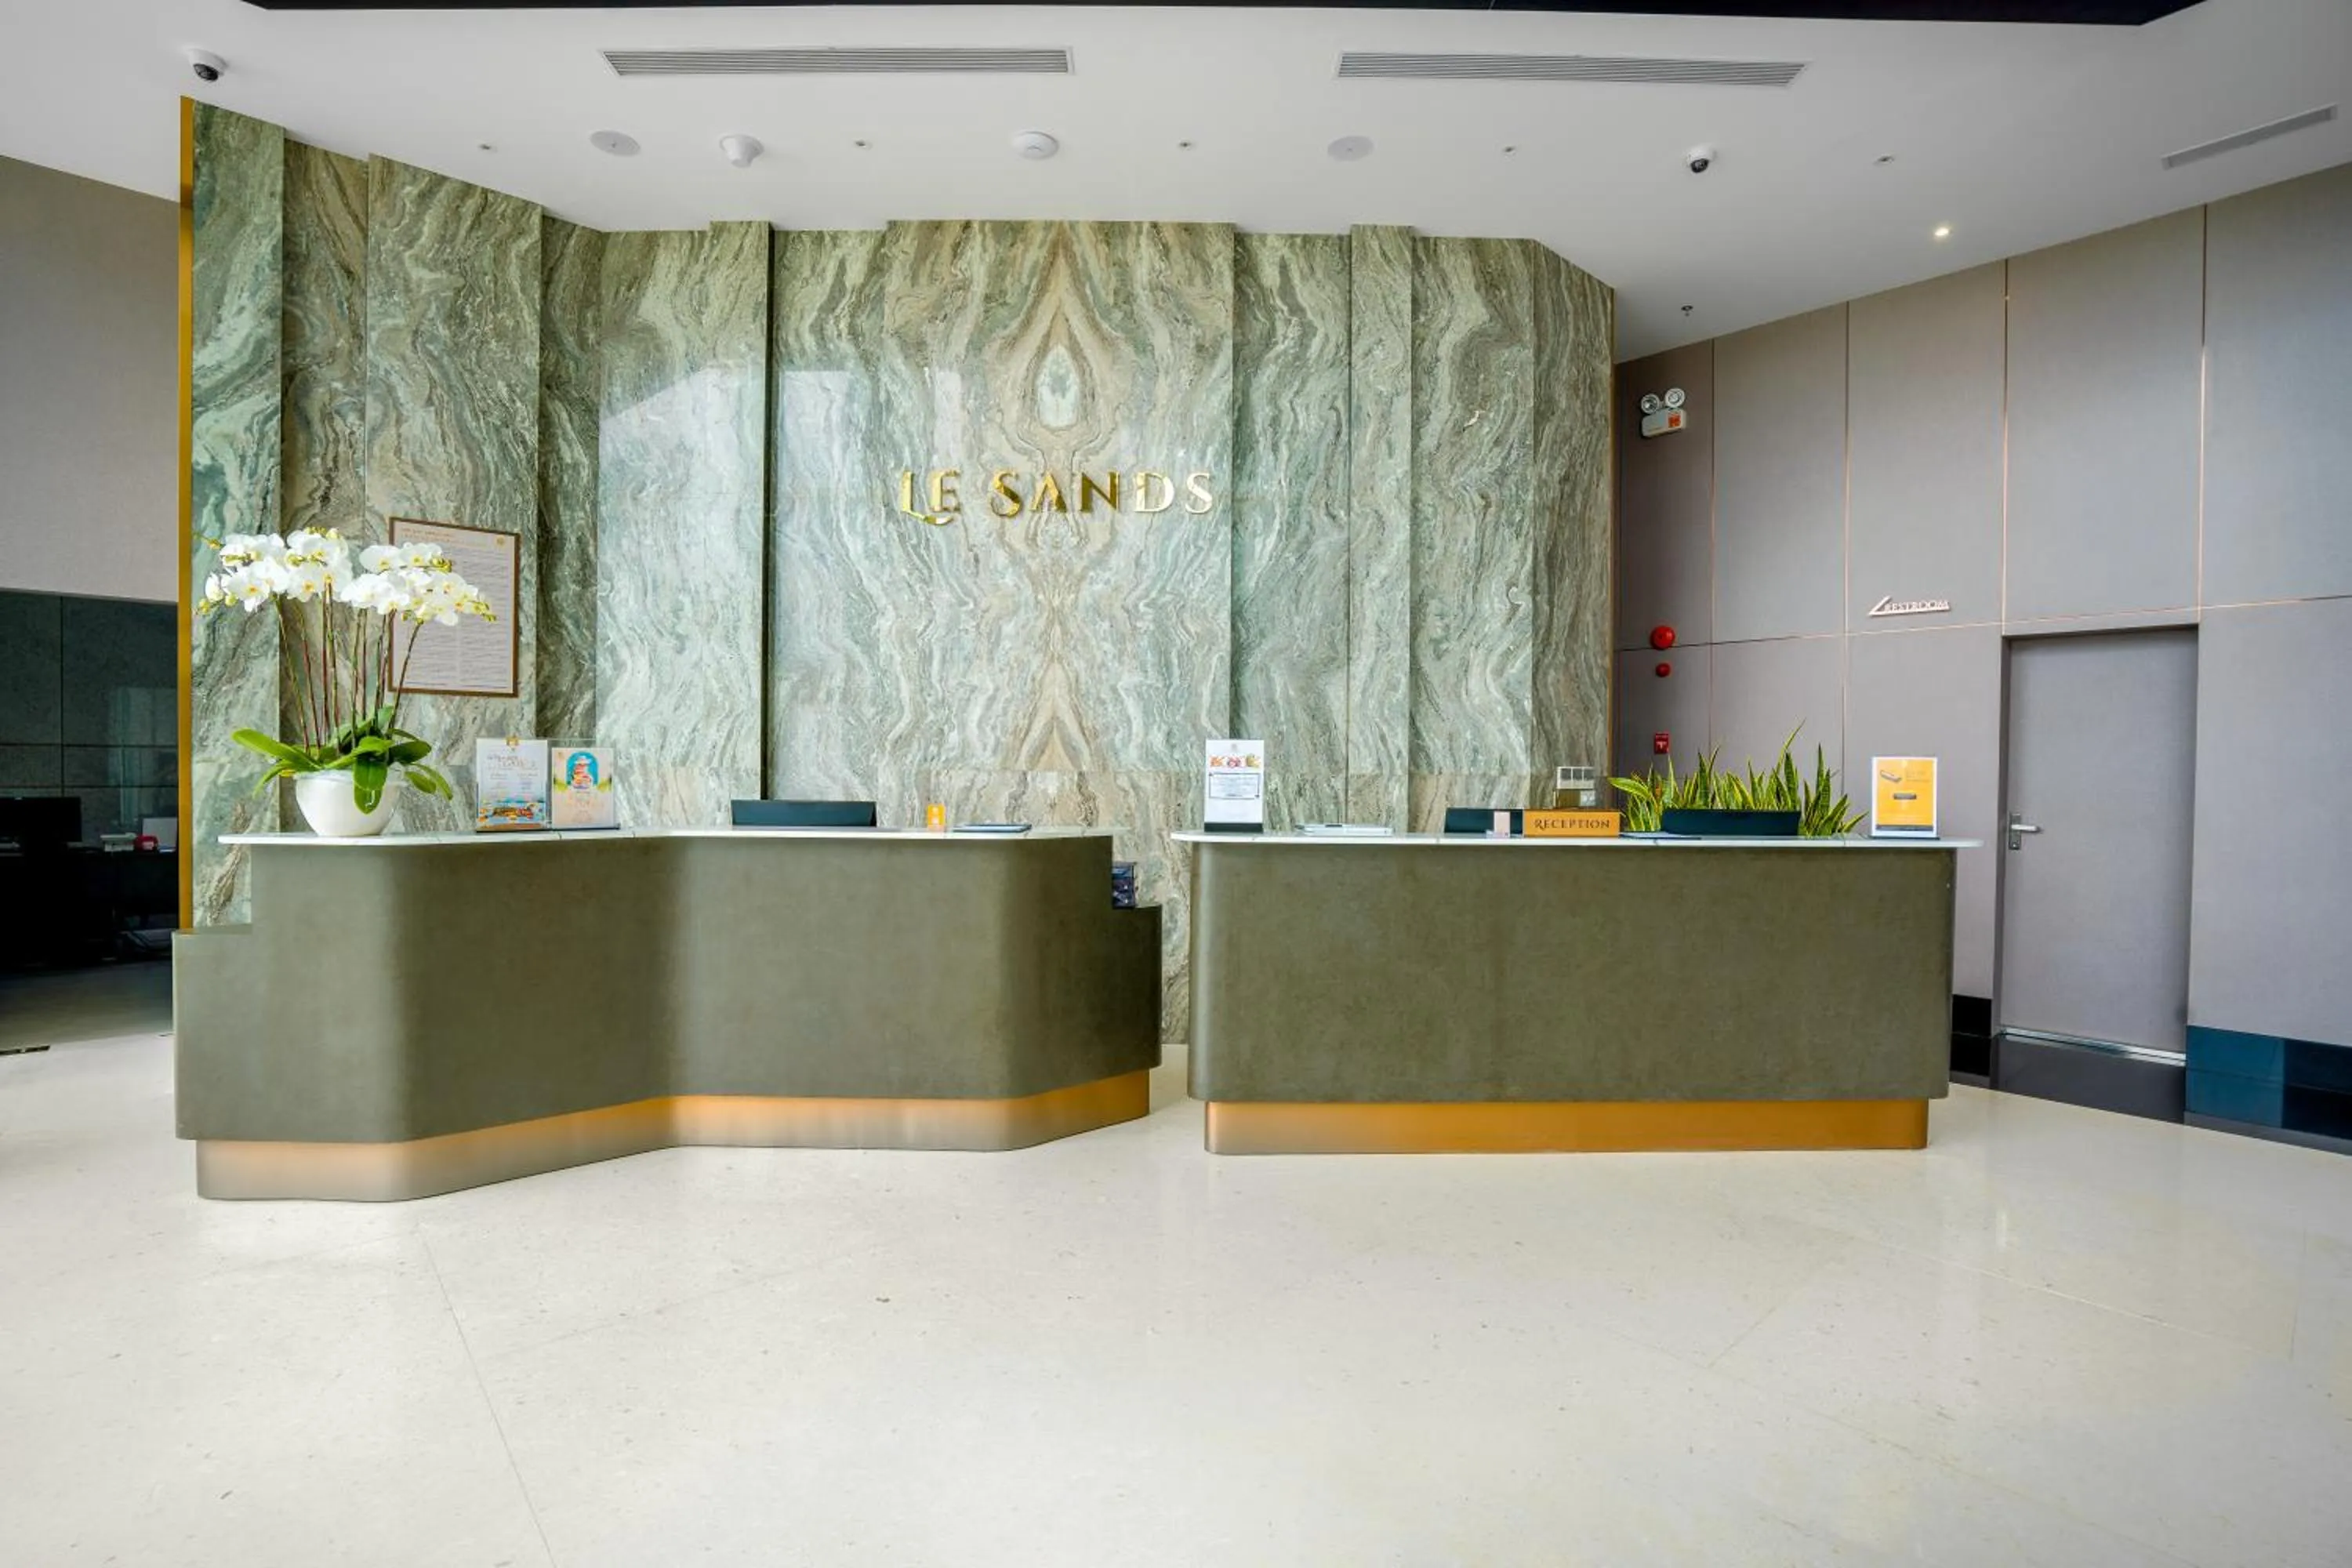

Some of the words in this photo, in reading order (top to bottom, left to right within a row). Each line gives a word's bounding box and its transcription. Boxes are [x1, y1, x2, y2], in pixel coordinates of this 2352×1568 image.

[901, 470, 960, 525] LE
[990, 470, 1214, 516] SANDS
[1534, 818, 1610, 831] RECEPTION
